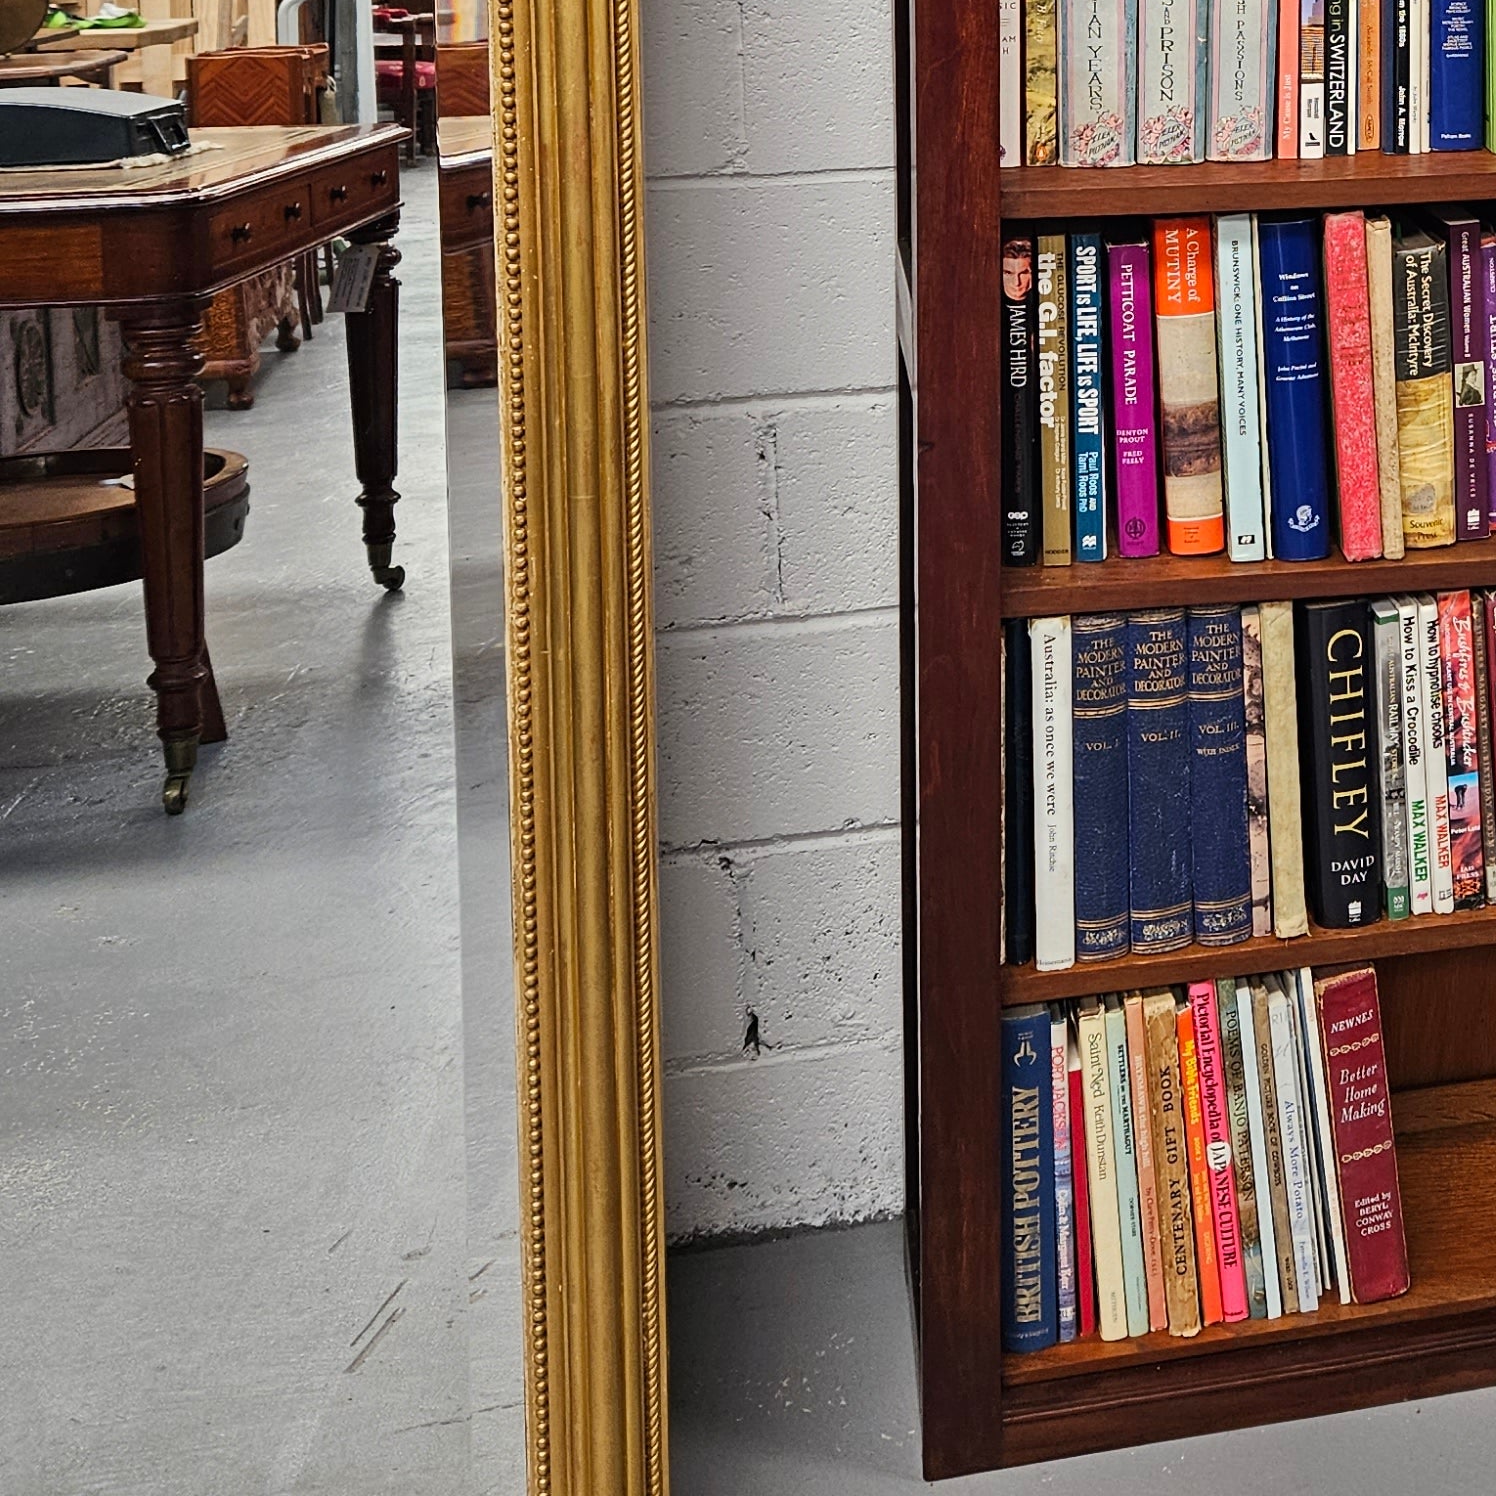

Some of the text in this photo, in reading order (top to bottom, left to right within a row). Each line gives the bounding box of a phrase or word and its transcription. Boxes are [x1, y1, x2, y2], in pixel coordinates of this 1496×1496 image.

[1331, 20, 1344, 31] in
[1235, 21, 1247, 101] PASSIONS
[1088, 45, 1103, 110] YEARS
[1329, 34, 1345, 147] SWITZERLAND
[1165, 229, 1181, 303] MUTINY
[1184, 228, 1200, 302] A Charge of
[1406, 256, 1420, 376] of Australia: McIntyre
[1420, 252, 1434, 367] The Secret Discovery
[1006, 304, 1027, 345] JAMES
[1121, 264, 1137, 405] PETTICOAT PARADE
[1231, 240, 1246, 435] BRUNSWICK: ONE HISTORY, MANY VOICES
[1038, 252, 1058, 428] the G.I. factor
[1075, 246, 1099, 434] SPORT IS LIFE, LIFE IS SPORT
[1010, 349, 1027, 387] HIRD
[1469, 459, 1475, 468] DE
[1149, 630, 1173, 641] THE
[1193, 632, 1239, 647] MODERN
[1206, 623, 1230, 633] THE
[1403, 616, 1416, 643] How
[1078, 647, 1124, 663] MODERN
[1091, 638, 1115, 649] THE
[1135, 640, 1183, 655] MODERN
[1191, 647, 1240, 662] PAINTER
[1405, 648, 1415, 660] to
[1076, 660, 1126, 677] PAINTER
[1133, 654, 1185, 670] PAINTER
[1148, 669, 1171, 680] AND
[1205, 662, 1228, 672] AND
[1091, 677, 1113, 687] AND
[1405, 664, 1417, 691] Kiss
[1425, 619, 1445, 749] How to hypnotise chooks
[1043, 634, 1058, 816] Australia: as once we were
[1327, 629, 1369, 840] CHIFLEY
[1407, 706, 1421, 765] Crocodile
[1411, 800, 1428, 882] MAX WALKER
[1435, 794, 1449, 869] MAX WALKER
[1331, 855, 1375, 872] DAVID
[1341, 871, 1368, 886] DAY
[1330, 1009, 1375, 1034] NEWNES
[1339, 1064, 1378, 1085] Better
[1225, 1011, 1254, 1201] POEMS OF BANJO PATERSON
[1344, 1084, 1378, 1104] Home
[1341, 1099, 1386, 1124] Making
[1092, 1105, 1109, 1181] Keith Dunstan
[1158, 1067, 1188, 1276] CENTENARY GIFT BOOK
[1011, 1085, 1042, 1323] BRITISH POTTERY
[1360, 1221, 1392, 1237] CROSS
